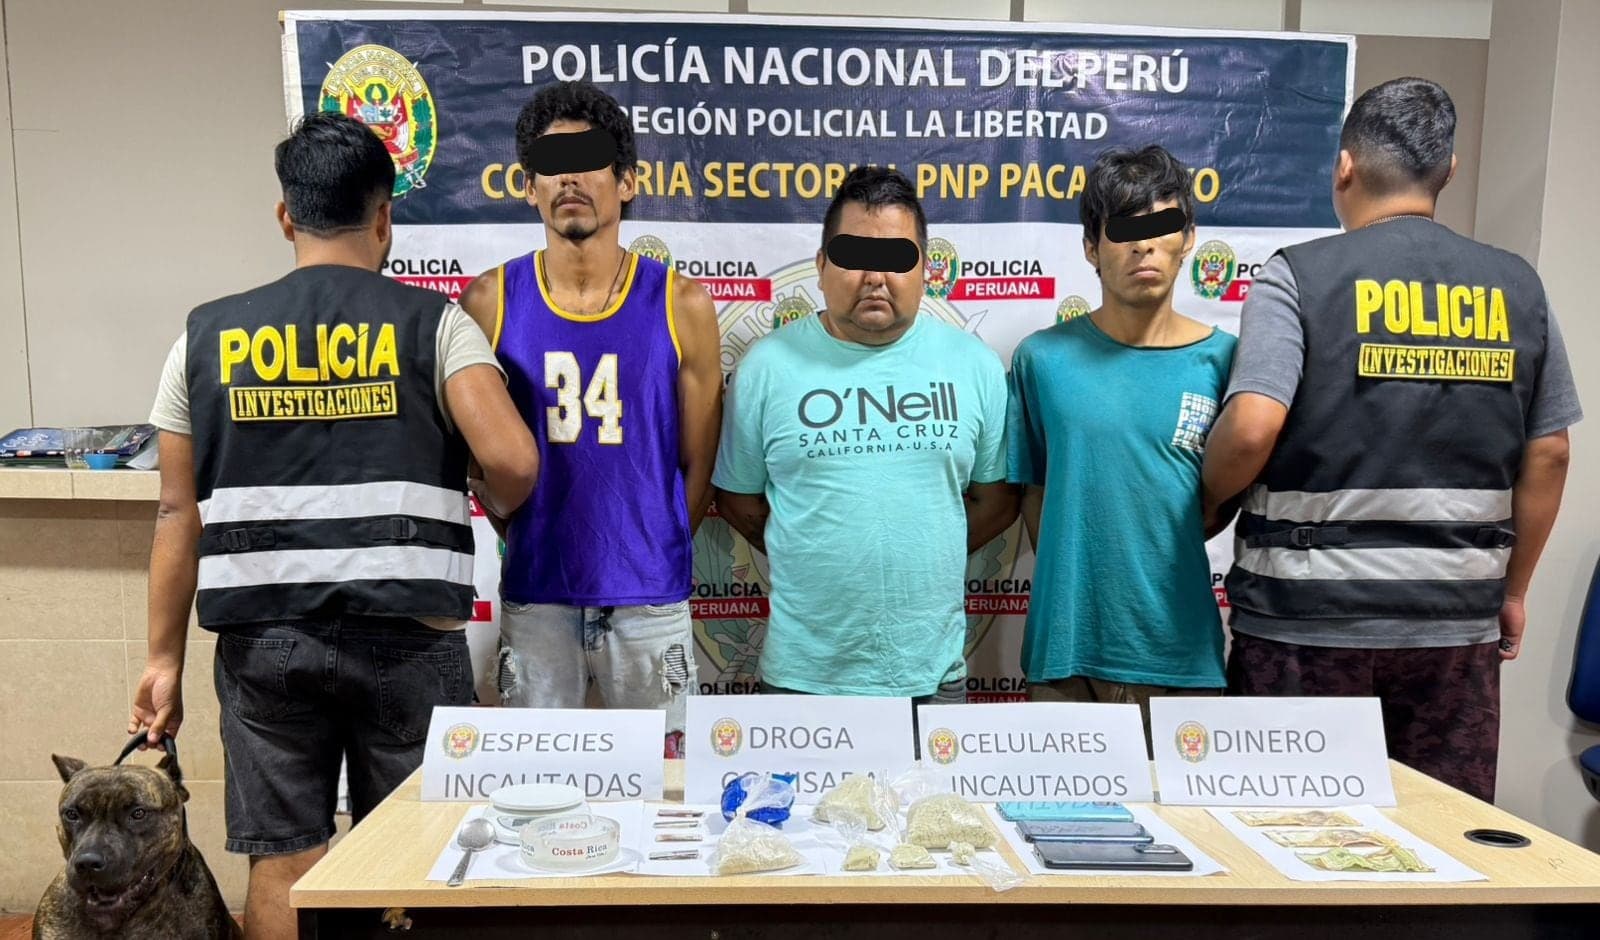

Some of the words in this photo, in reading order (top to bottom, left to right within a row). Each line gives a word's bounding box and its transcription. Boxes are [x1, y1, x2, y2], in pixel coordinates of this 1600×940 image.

[522, 37, 711, 84] POLICÍA
[724, 46, 966, 87] NACIONAL
[979, 49, 1064, 88] DEL
[1077, 49, 1189, 94] PERÚ
[619, 101, 736, 137] EGIÓN
[748, 108, 896, 138] POLICIAL
[906, 109, 946, 138] LA
[956, 110, 1108, 140] LIBERTAD
[481, 160, 694, 199] CORIA
[703, 161, 897, 199] SECTOR
[916, 163, 990, 200] PNP
[675, 260, 758, 277] POLICIA
[961, 260, 1043, 276] POLICIA
[702, 283, 756, 297] RUANA
[966, 282, 1040, 296] PERUANA
[1363, 347, 1509, 378] INVESTIGACIONES
[237, 386, 391, 417] INVESTIGACIONES
[544, 351, 623, 444] 34
[798, 382, 958, 428] O'Neill
[799, 428, 882, 448] SANTA
[897, 424, 958, 438] CRUZ
[481, 733, 614, 752] ESPECIES
[749, 727, 854, 749] DROGA
[961, 732, 1107, 754] CELULARES
[1213, 730, 1326, 753] DINERO
[952, 775, 1128, 797] INCAUTADOS
[1186, 774, 1365, 798] INCAUTADO
[551, 847, 584, 856] Costa
[587, 844, 607, 854] Rica
